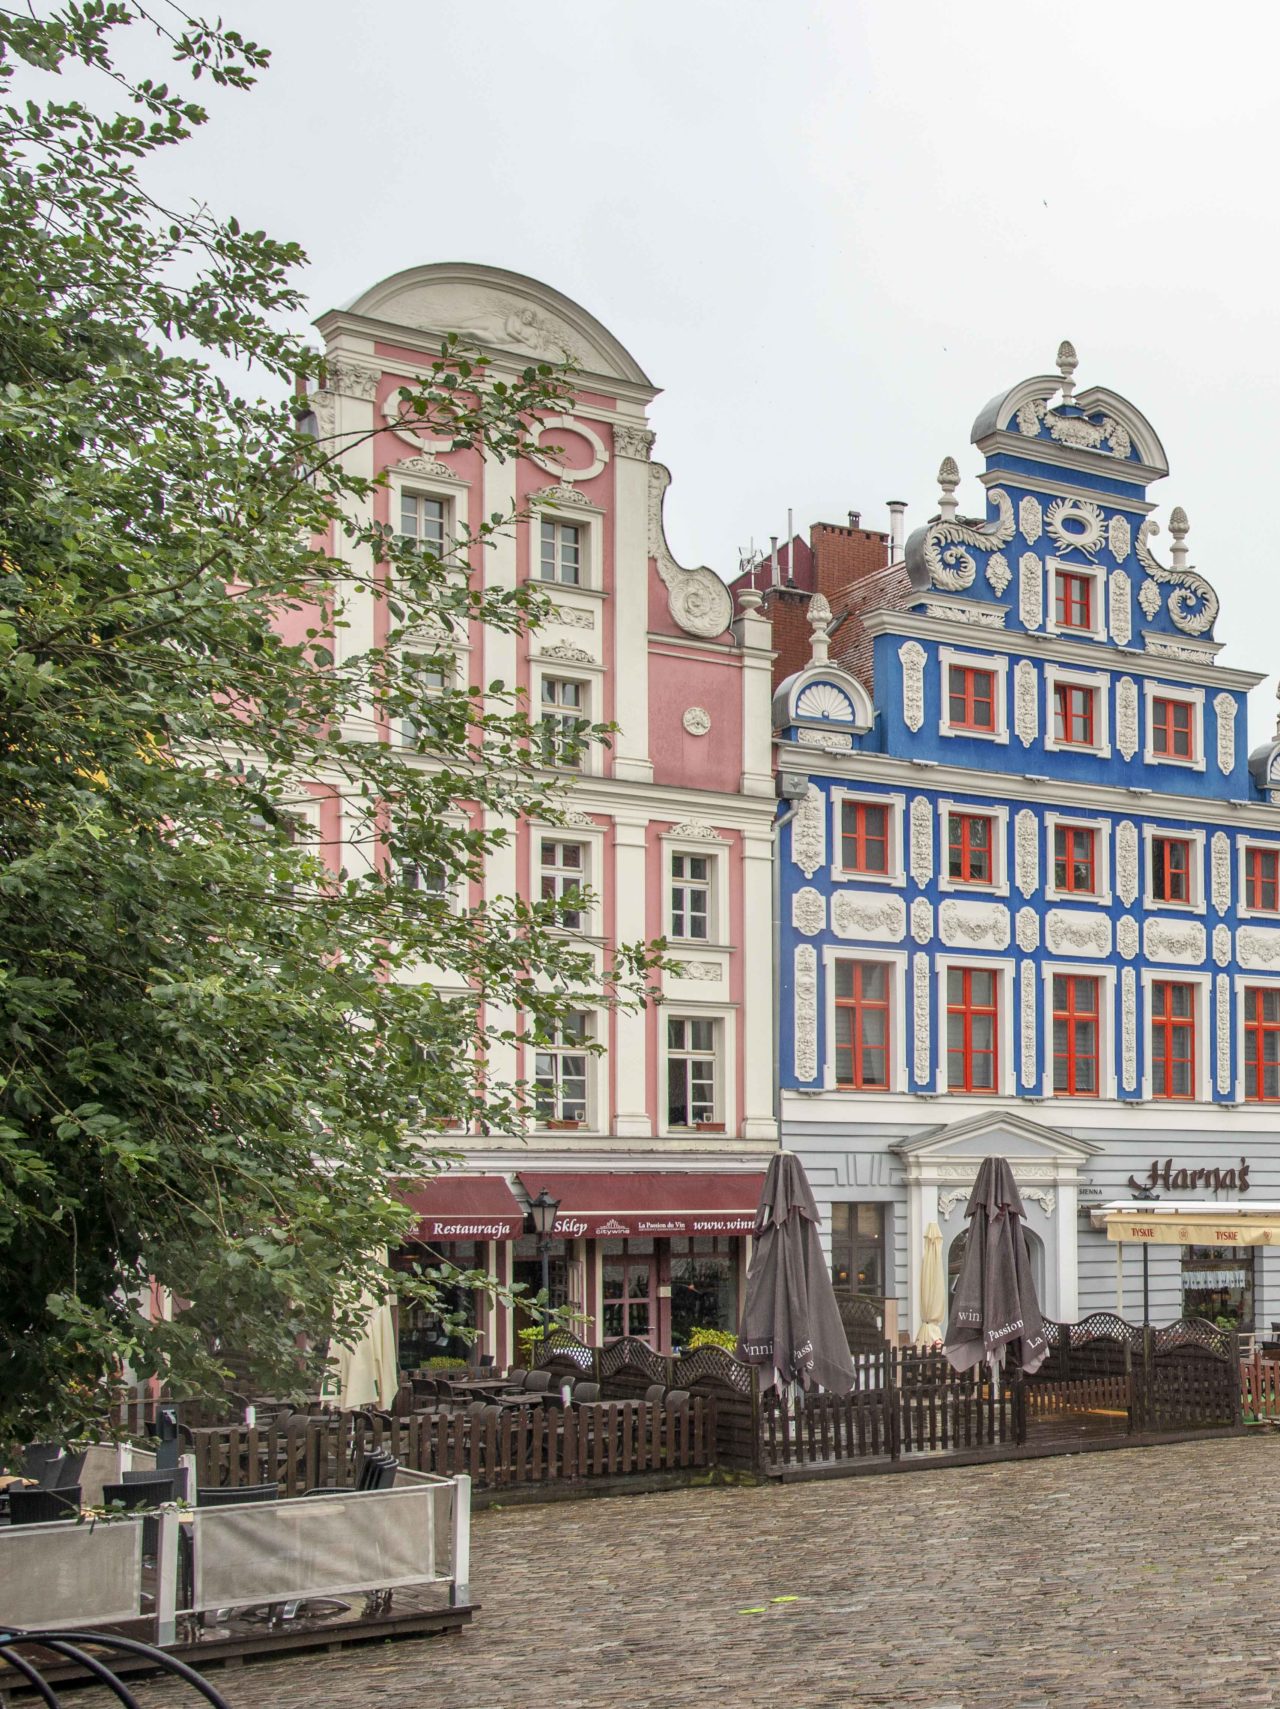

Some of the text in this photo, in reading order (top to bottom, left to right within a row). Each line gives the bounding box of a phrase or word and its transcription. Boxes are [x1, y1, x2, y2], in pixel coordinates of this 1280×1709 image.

[433, 1222, 510, 1239] Restauracja
[554, 1218, 588, 1237] Sklep
[1131, 1228, 1155, 1237] TYSKIE
[1215, 1231, 1239, 1241] TYSKIE
[987, 1319, 1024, 1341] Passion
[1026, 1335, 1043, 1348] La
